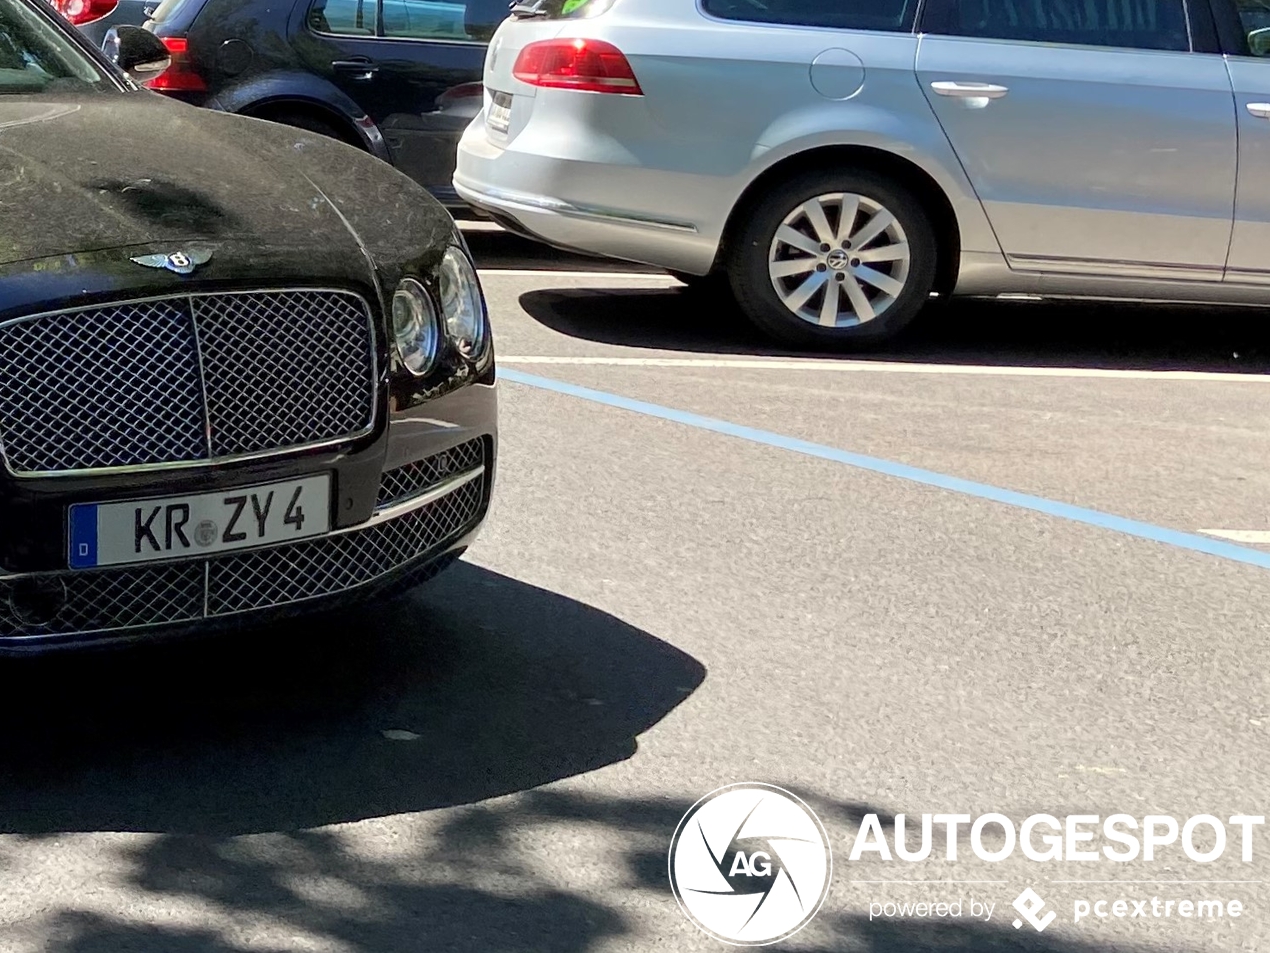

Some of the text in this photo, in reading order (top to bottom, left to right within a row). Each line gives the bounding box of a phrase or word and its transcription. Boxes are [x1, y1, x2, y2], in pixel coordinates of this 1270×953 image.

[134, 486, 305, 553] KR ZY 4
[79, 543, 88, 556] D
